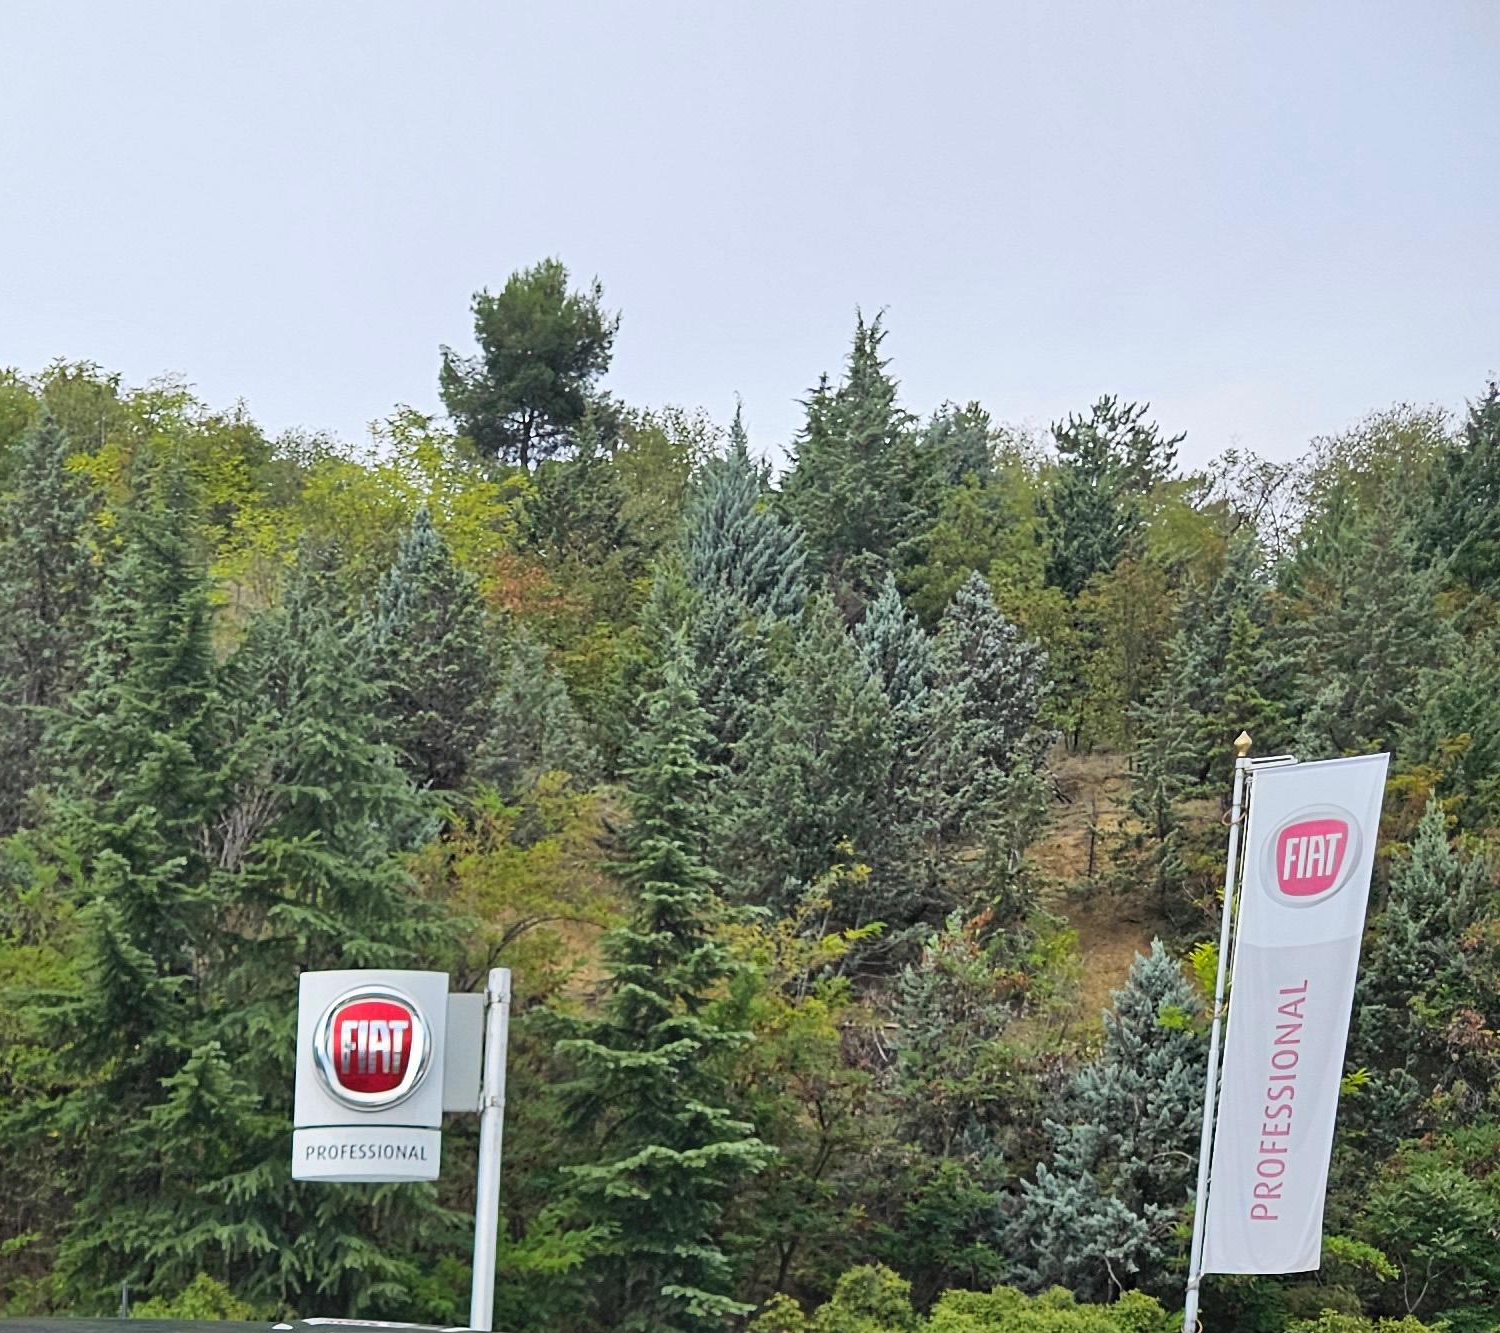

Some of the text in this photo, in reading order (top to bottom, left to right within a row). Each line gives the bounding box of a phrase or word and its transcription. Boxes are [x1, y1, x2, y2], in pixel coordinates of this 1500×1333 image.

[1283, 833, 1342, 880] FIAT
[341, 1020, 408, 1074] FIAT
[1250, 979, 1308, 1221] PROFESSIONAL
[305, 1144, 427, 1161] PROFESSIONAL
